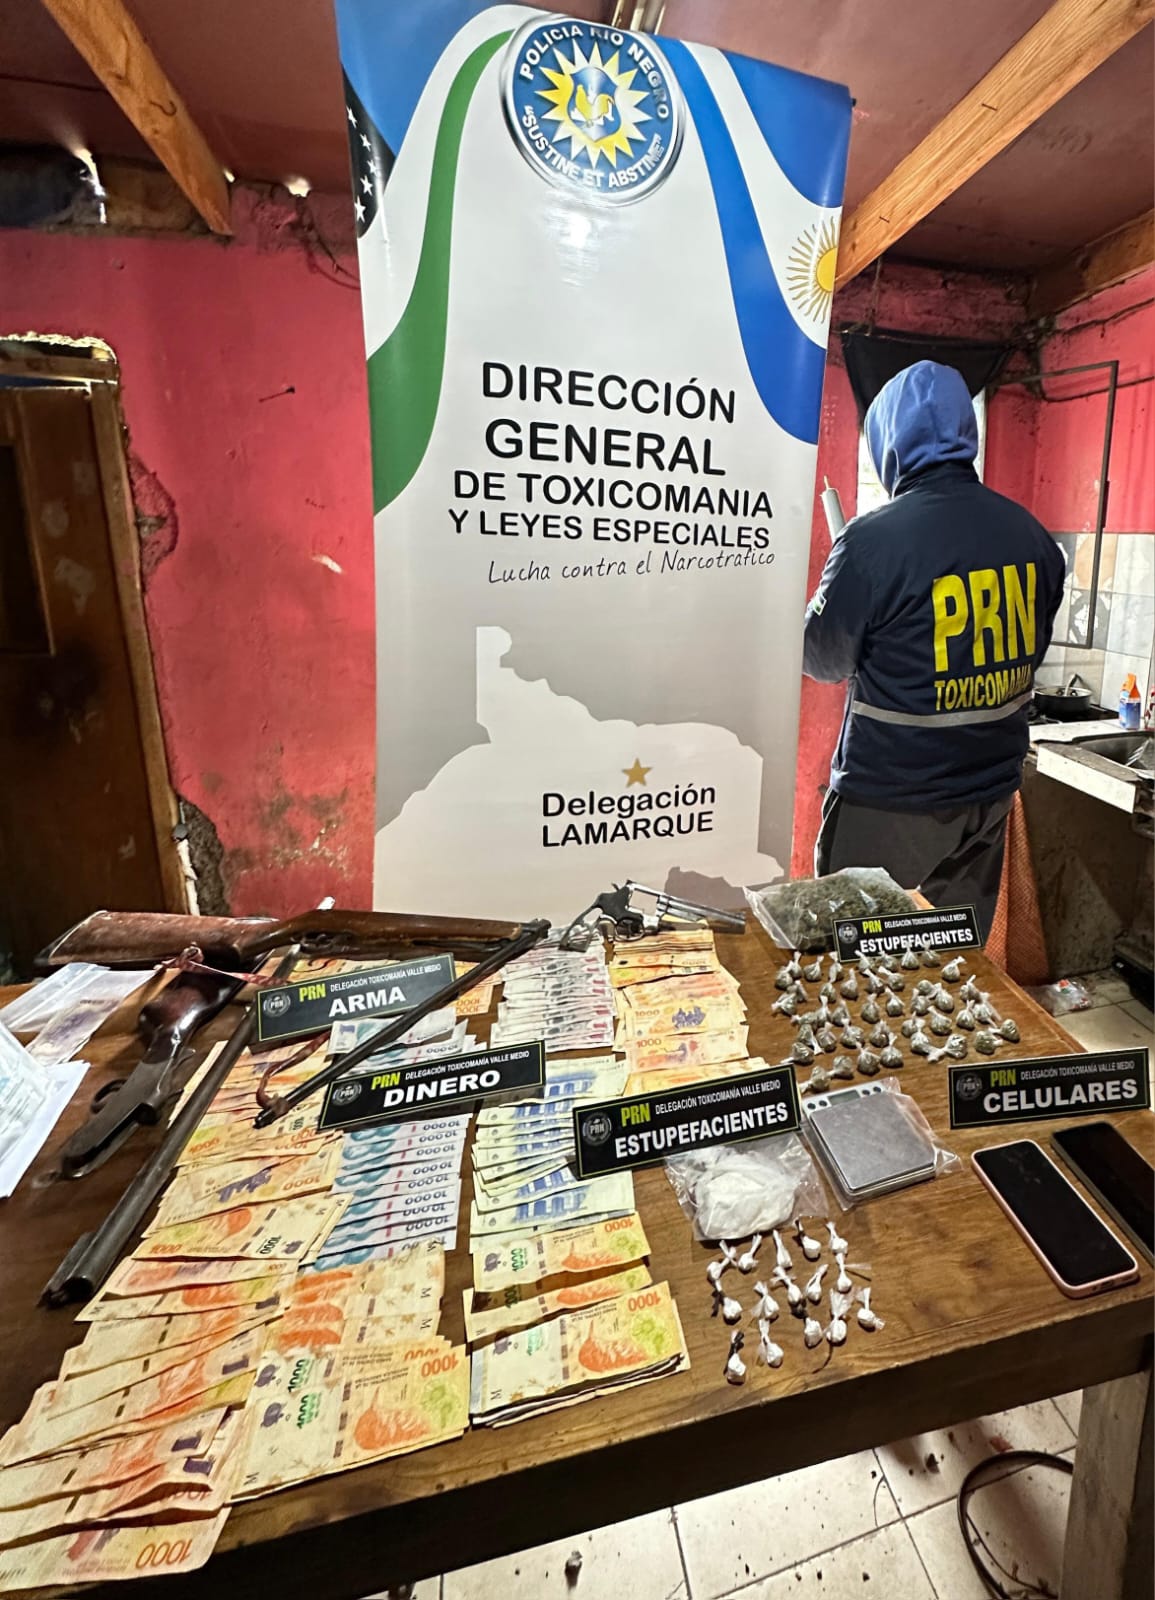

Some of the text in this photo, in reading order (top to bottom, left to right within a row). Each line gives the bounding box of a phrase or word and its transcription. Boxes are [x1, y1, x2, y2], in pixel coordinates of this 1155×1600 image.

[520, 24, 670, 119] POLICIA RIO NEGRO
[582, 168, 605, 188] ET
[482, 361, 736, 424] DIRECCIÓN
[485, 418, 726, 476] GENERAL
[454, 470, 774, 518] DE TOXICOMANIA
[448, 508, 770, 548] Y LEYES ESPECIALES
[488, 560, 551, 584] Lucha
[561, 557, 627, 579] contra
[635, 550, 652, 574] el
[931, 562, 1037, 673] PRN
[542, 783, 715, 819] Delegación
[542, 811, 714, 848] LAMARQUE
[860, 928, 973, 953] ESTUPEFACIENTES
[862, 919, 883, 934] PRN
[299, 983, 326, 1002] PRN
[330, 977, 368, 993] DELEGACIÓN
[406, 967, 424, 977] VALLE
[424, 963, 442, 973] MEDIO
[328, 986, 407, 1018] ARMA
[636, 1038, 662, 1048] 1000
[371, 1050, 530, 1090] PRN DELEGACIÓN TOXICOMANÍA VALLE MEDIO
[990, 1069, 1017, 1087] PRN
[1020, 1068, 1058, 1081] DELEGACIÓN
[1097, 1061, 1117, 1072] VALLE
[1117, 1060, 1135, 1070] MEDIO
[383, 1070, 501, 1108] DINERO
[620, 1079, 781, 1128] PRN DELEGACIÓN TOXICOMANÍA VALLE MEDIO
[983, 1078, 1138, 1114] CELULARES
[615, 1101, 789, 1159] ESTUPEFACIENTES
[604, 1218, 634, 1233] 1000
[628, 1291, 662, 1312] 1000
[288, 1358, 308, 1393] 1000
[421, 1352, 458, 1378] 1000
[297, 1393, 314, 1429] 1000
[135, 1538, 192, 1569] 1000
